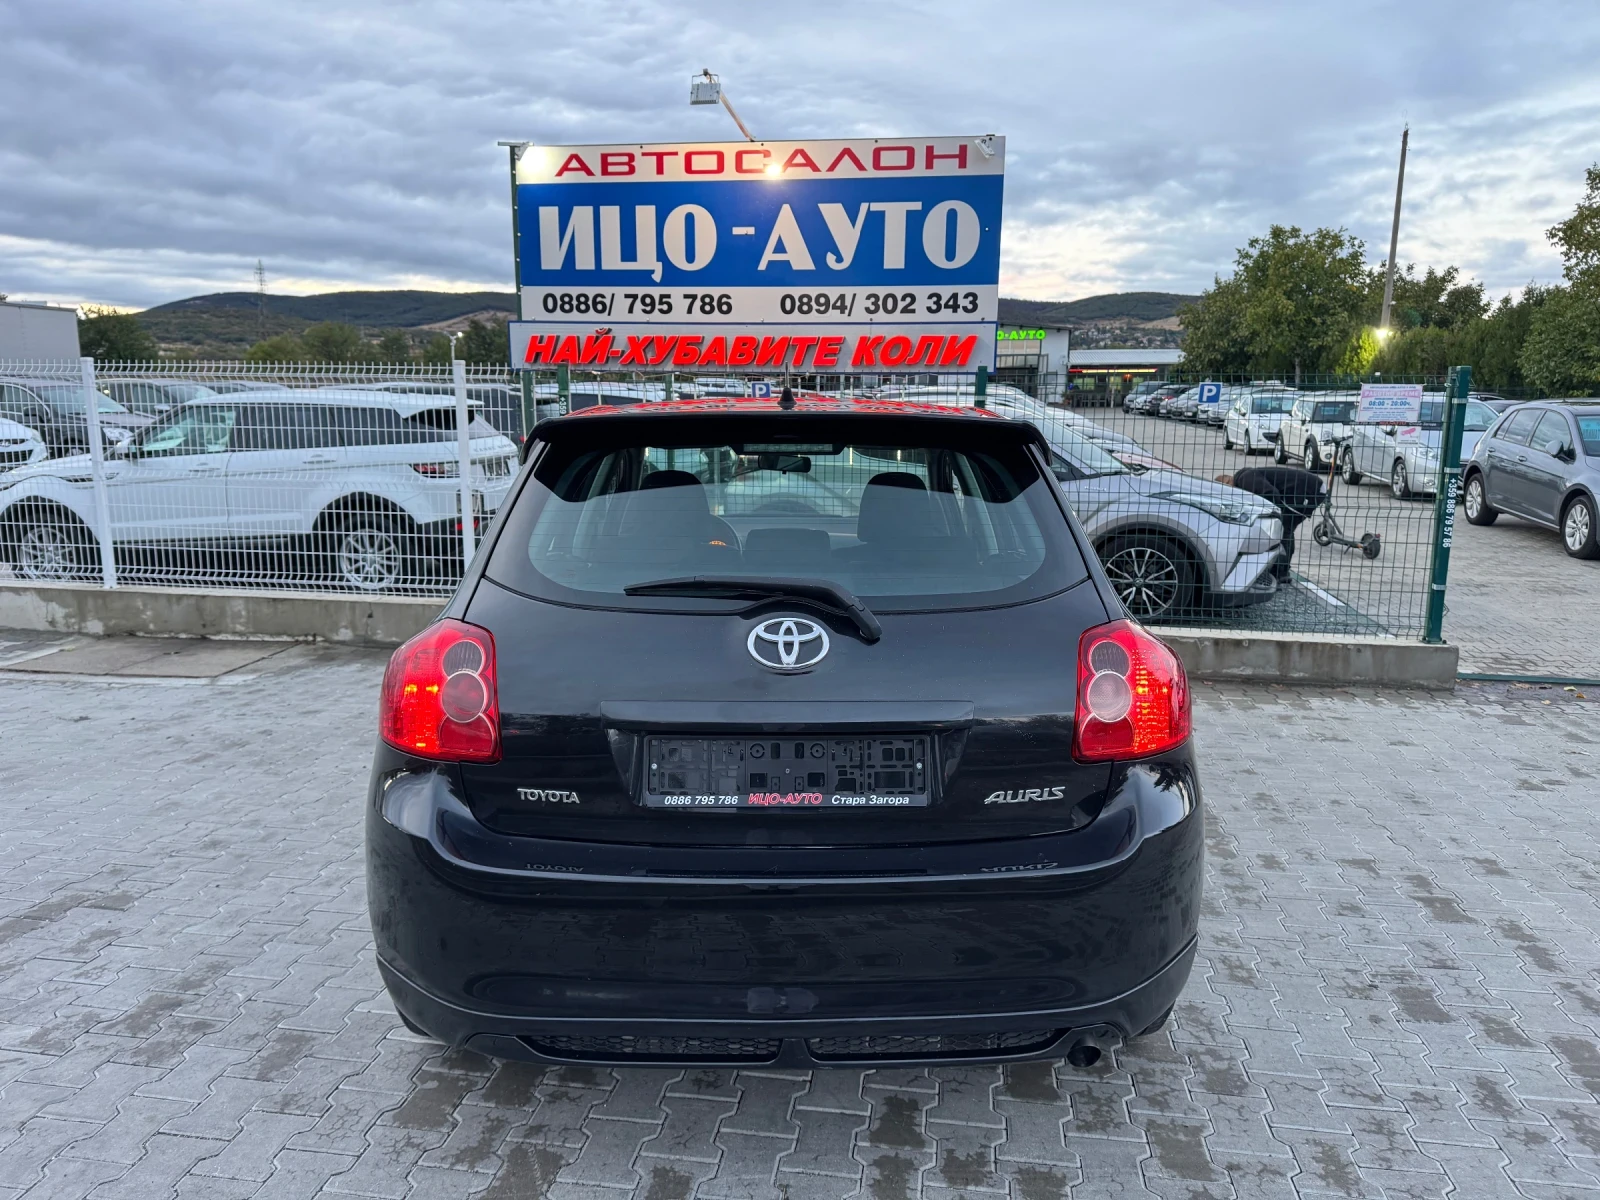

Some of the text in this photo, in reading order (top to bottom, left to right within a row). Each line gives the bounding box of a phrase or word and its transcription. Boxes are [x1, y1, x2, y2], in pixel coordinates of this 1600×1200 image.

[555, 144, 967, 177] АВТОСАЛОН
[543, 292, 979, 316] 0886/ 795 786 0894/ 302 343
[524, 327, 978, 366] НАЙ-ХУБАВИТЕ КОЛИ
[755, 384, 766, 397] P
[1202, 386, 1216, 401] P
[1442, 478, 1457, 548] +359 886 79 57 86
[518, 789, 580, 804] TOYOTA
[664, 793, 909, 806] 0886 795 786 ИЦО-АУТО Стара Загора
[984, 786, 1065, 804] AURIS
